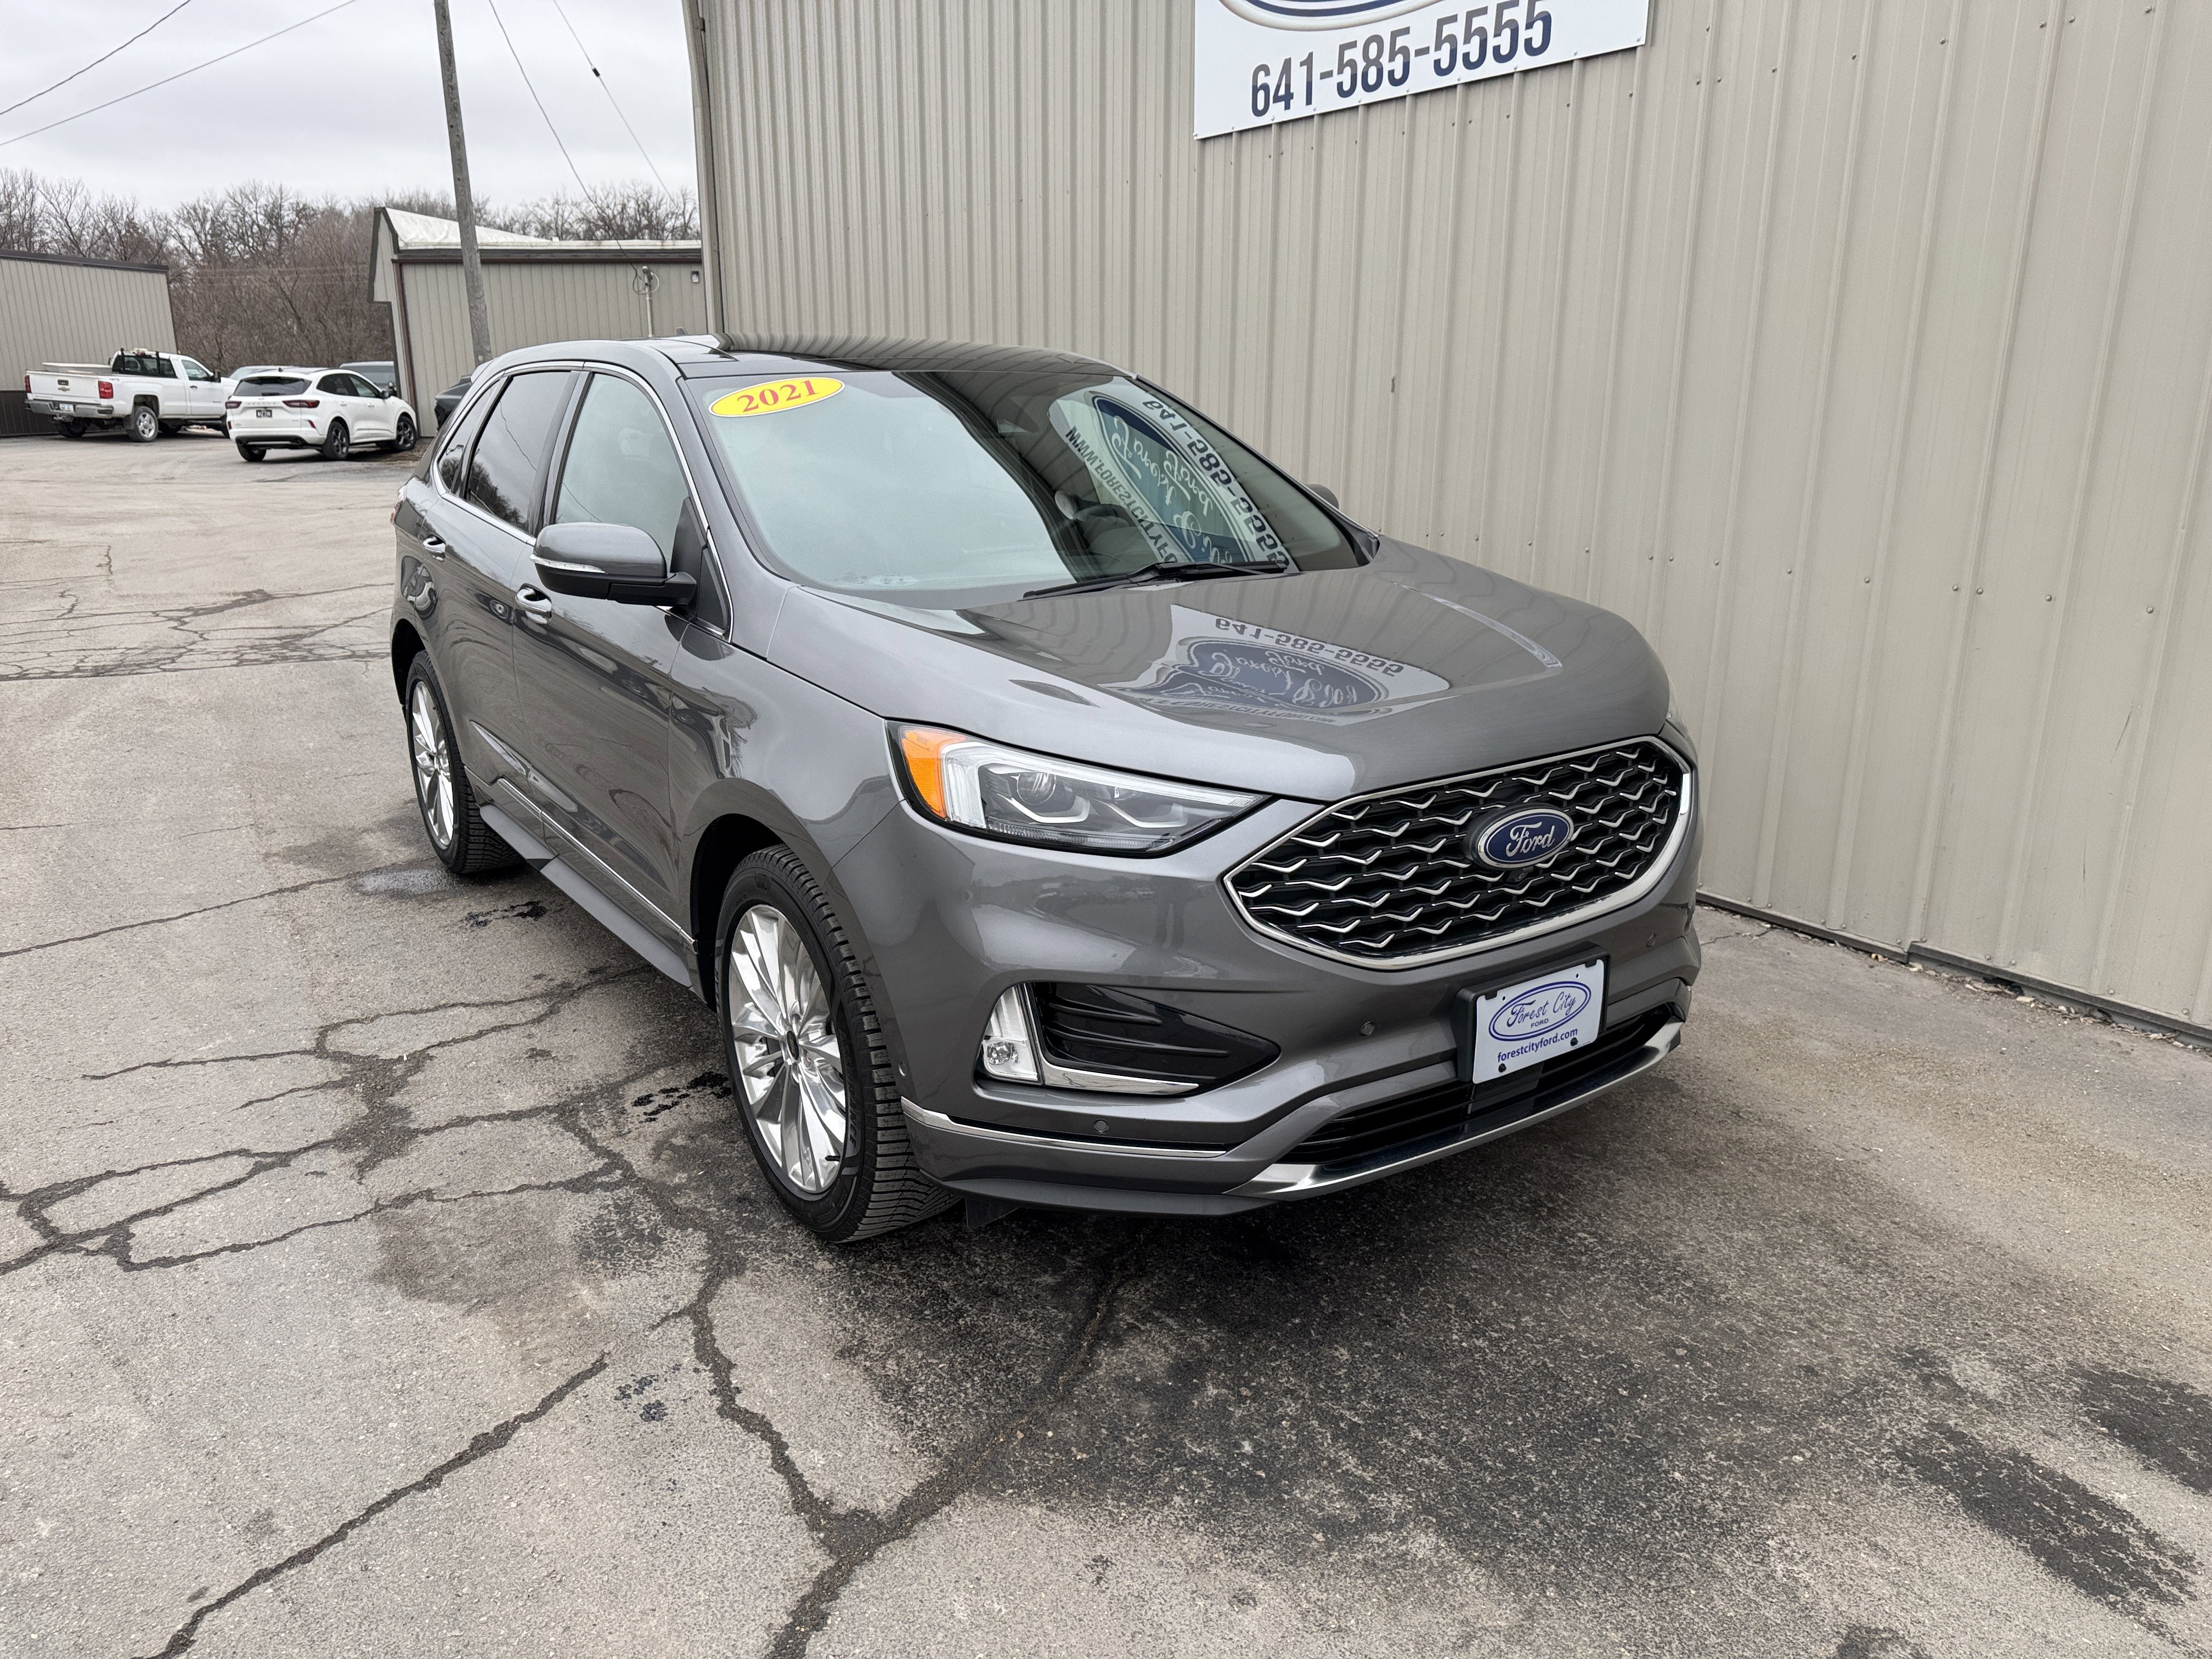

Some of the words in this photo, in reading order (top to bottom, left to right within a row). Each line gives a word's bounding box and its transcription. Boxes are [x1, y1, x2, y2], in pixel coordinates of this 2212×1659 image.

[1251, 0, 1551, 117] 641-585-5555
[737, 380, 820, 413] 2021
[1506, 822, 1555, 857] Ford
[1506, 1000, 1549, 1028] Forest
[1553, 991, 1577, 1016] City
[1531, 1013, 1549, 1028] FORD
[1498, 1029, 1578, 1063] forestcityford.com
